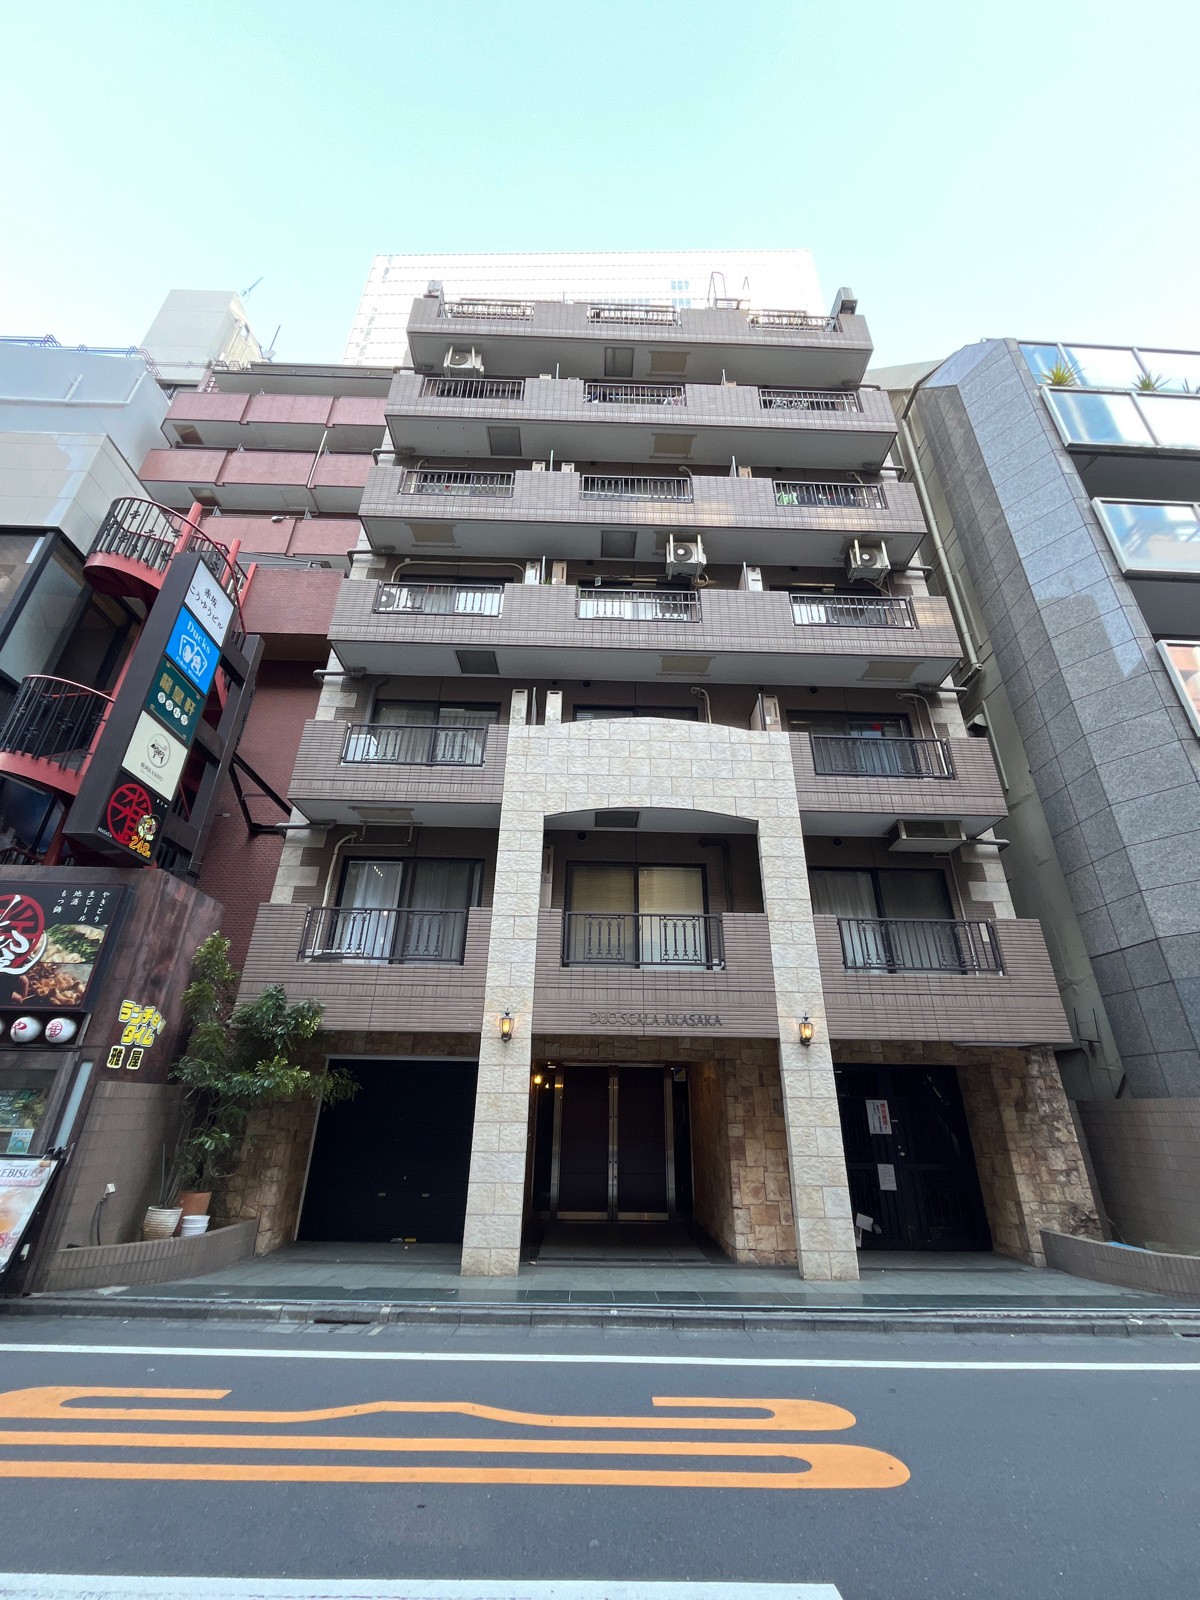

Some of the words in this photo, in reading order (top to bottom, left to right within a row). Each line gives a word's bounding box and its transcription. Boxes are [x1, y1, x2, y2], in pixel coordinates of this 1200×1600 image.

[190, 585, 223, 629] こうゆうビル
[205, 589, 217, 608] 赤坂
[187, 620, 210, 654] Ducks
[70, 890, 82, 906] 地酒
[78, 890, 95, 922] 生ビール
[94, 891, 110, 923] やきとり
[118, 1000, 156, 1025] ランチ
[663, 1013, 723, 1027] AKASAKA
[121, 1023, 155, 1047] タイム
[0, 1168, 30, 1178] EBISU
